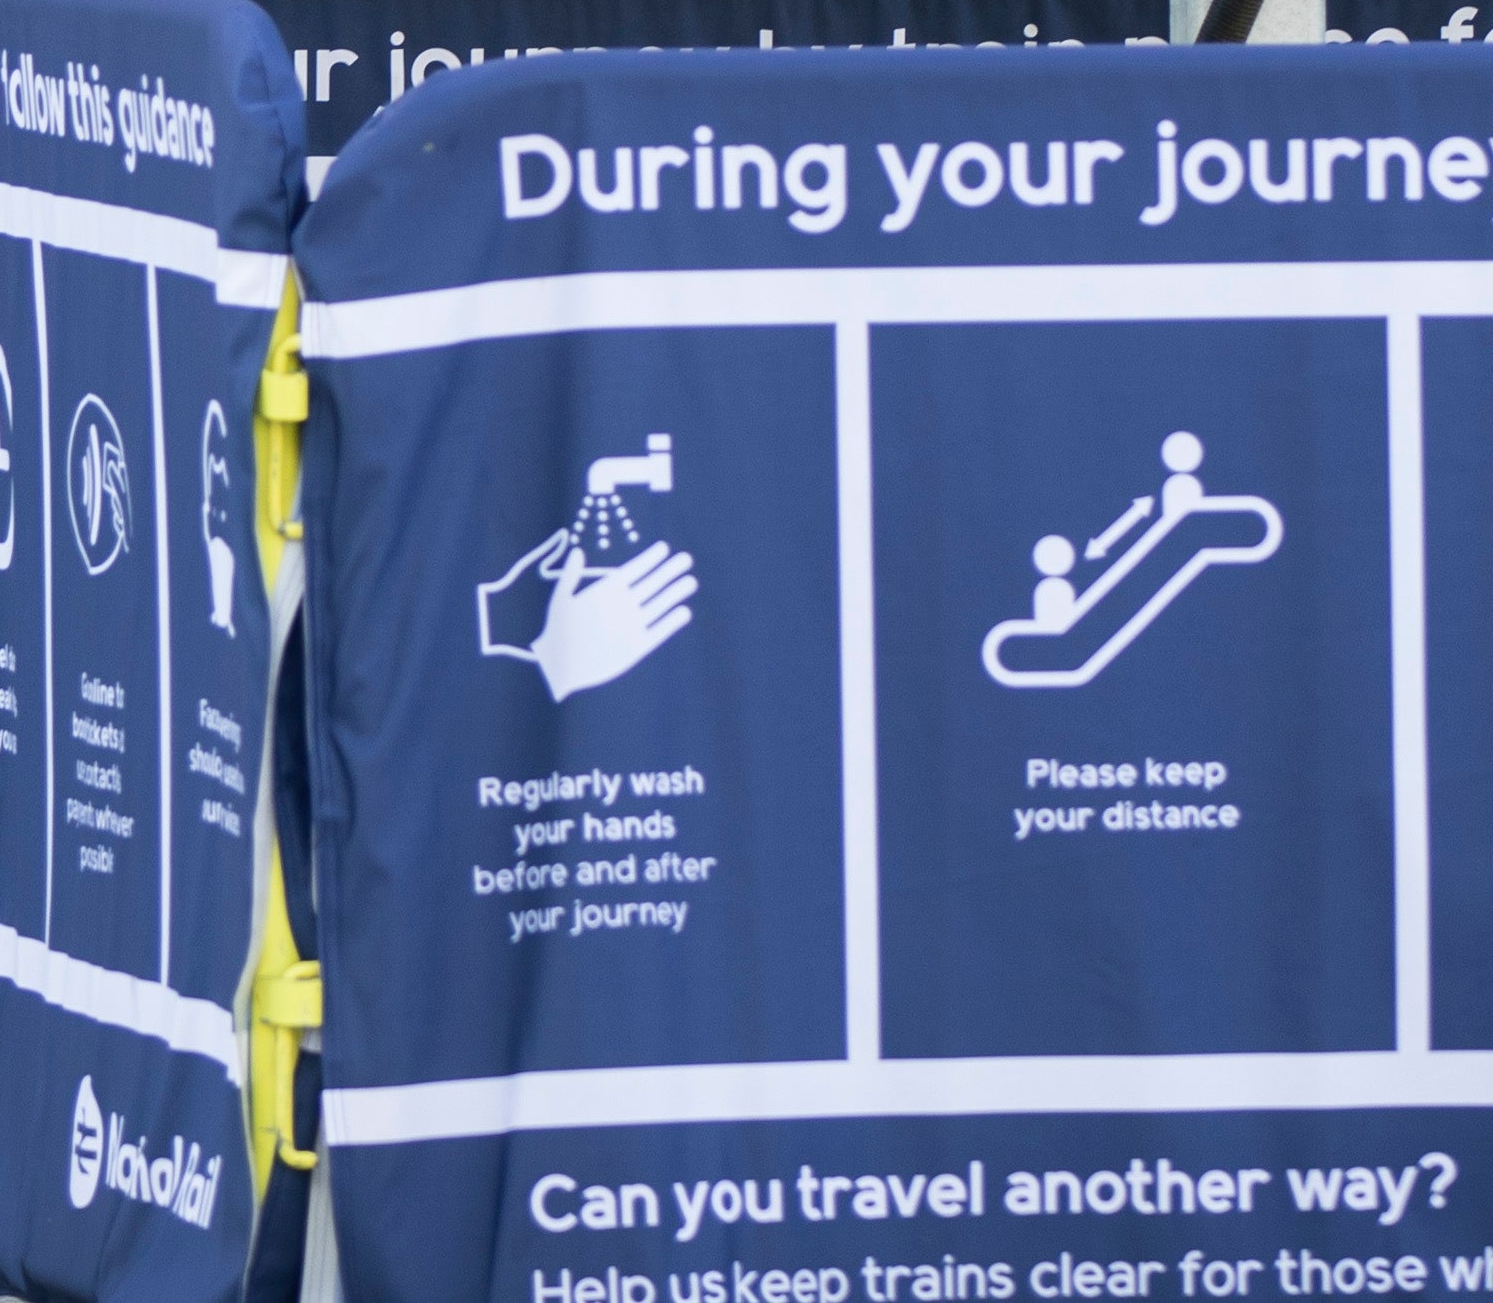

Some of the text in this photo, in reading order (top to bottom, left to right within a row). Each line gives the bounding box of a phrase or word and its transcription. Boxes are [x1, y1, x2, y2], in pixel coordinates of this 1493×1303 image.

[67, 60, 114, 146] this
[118, 73, 215, 174] guidance
[499, 125, 847, 235] During
[877, 133, 1124, 235] your
[478, 764, 705, 812] Regularly wash
[1026, 756, 1228, 792] Please keep
[514, 808, 677, 856] your hands
[1013, 799, 1241, 841] your distance
[472, 851, 718, 895] before and after
[508, 897, 689, 944] your journey
[529, 1151, 1458, 1243] Can you travel another way?
[531, 1265, 656, 1303] Help
[670, 1269, 727, 1303] us
[732, 1260, 850, 1303] keep
[860, 1253, 1015, 1303] trains
[1028, 1252, 1165, 1299] clear
[1178, 1249, 1264, 1298] for
[1275, 1247, 1428, 1296] those
